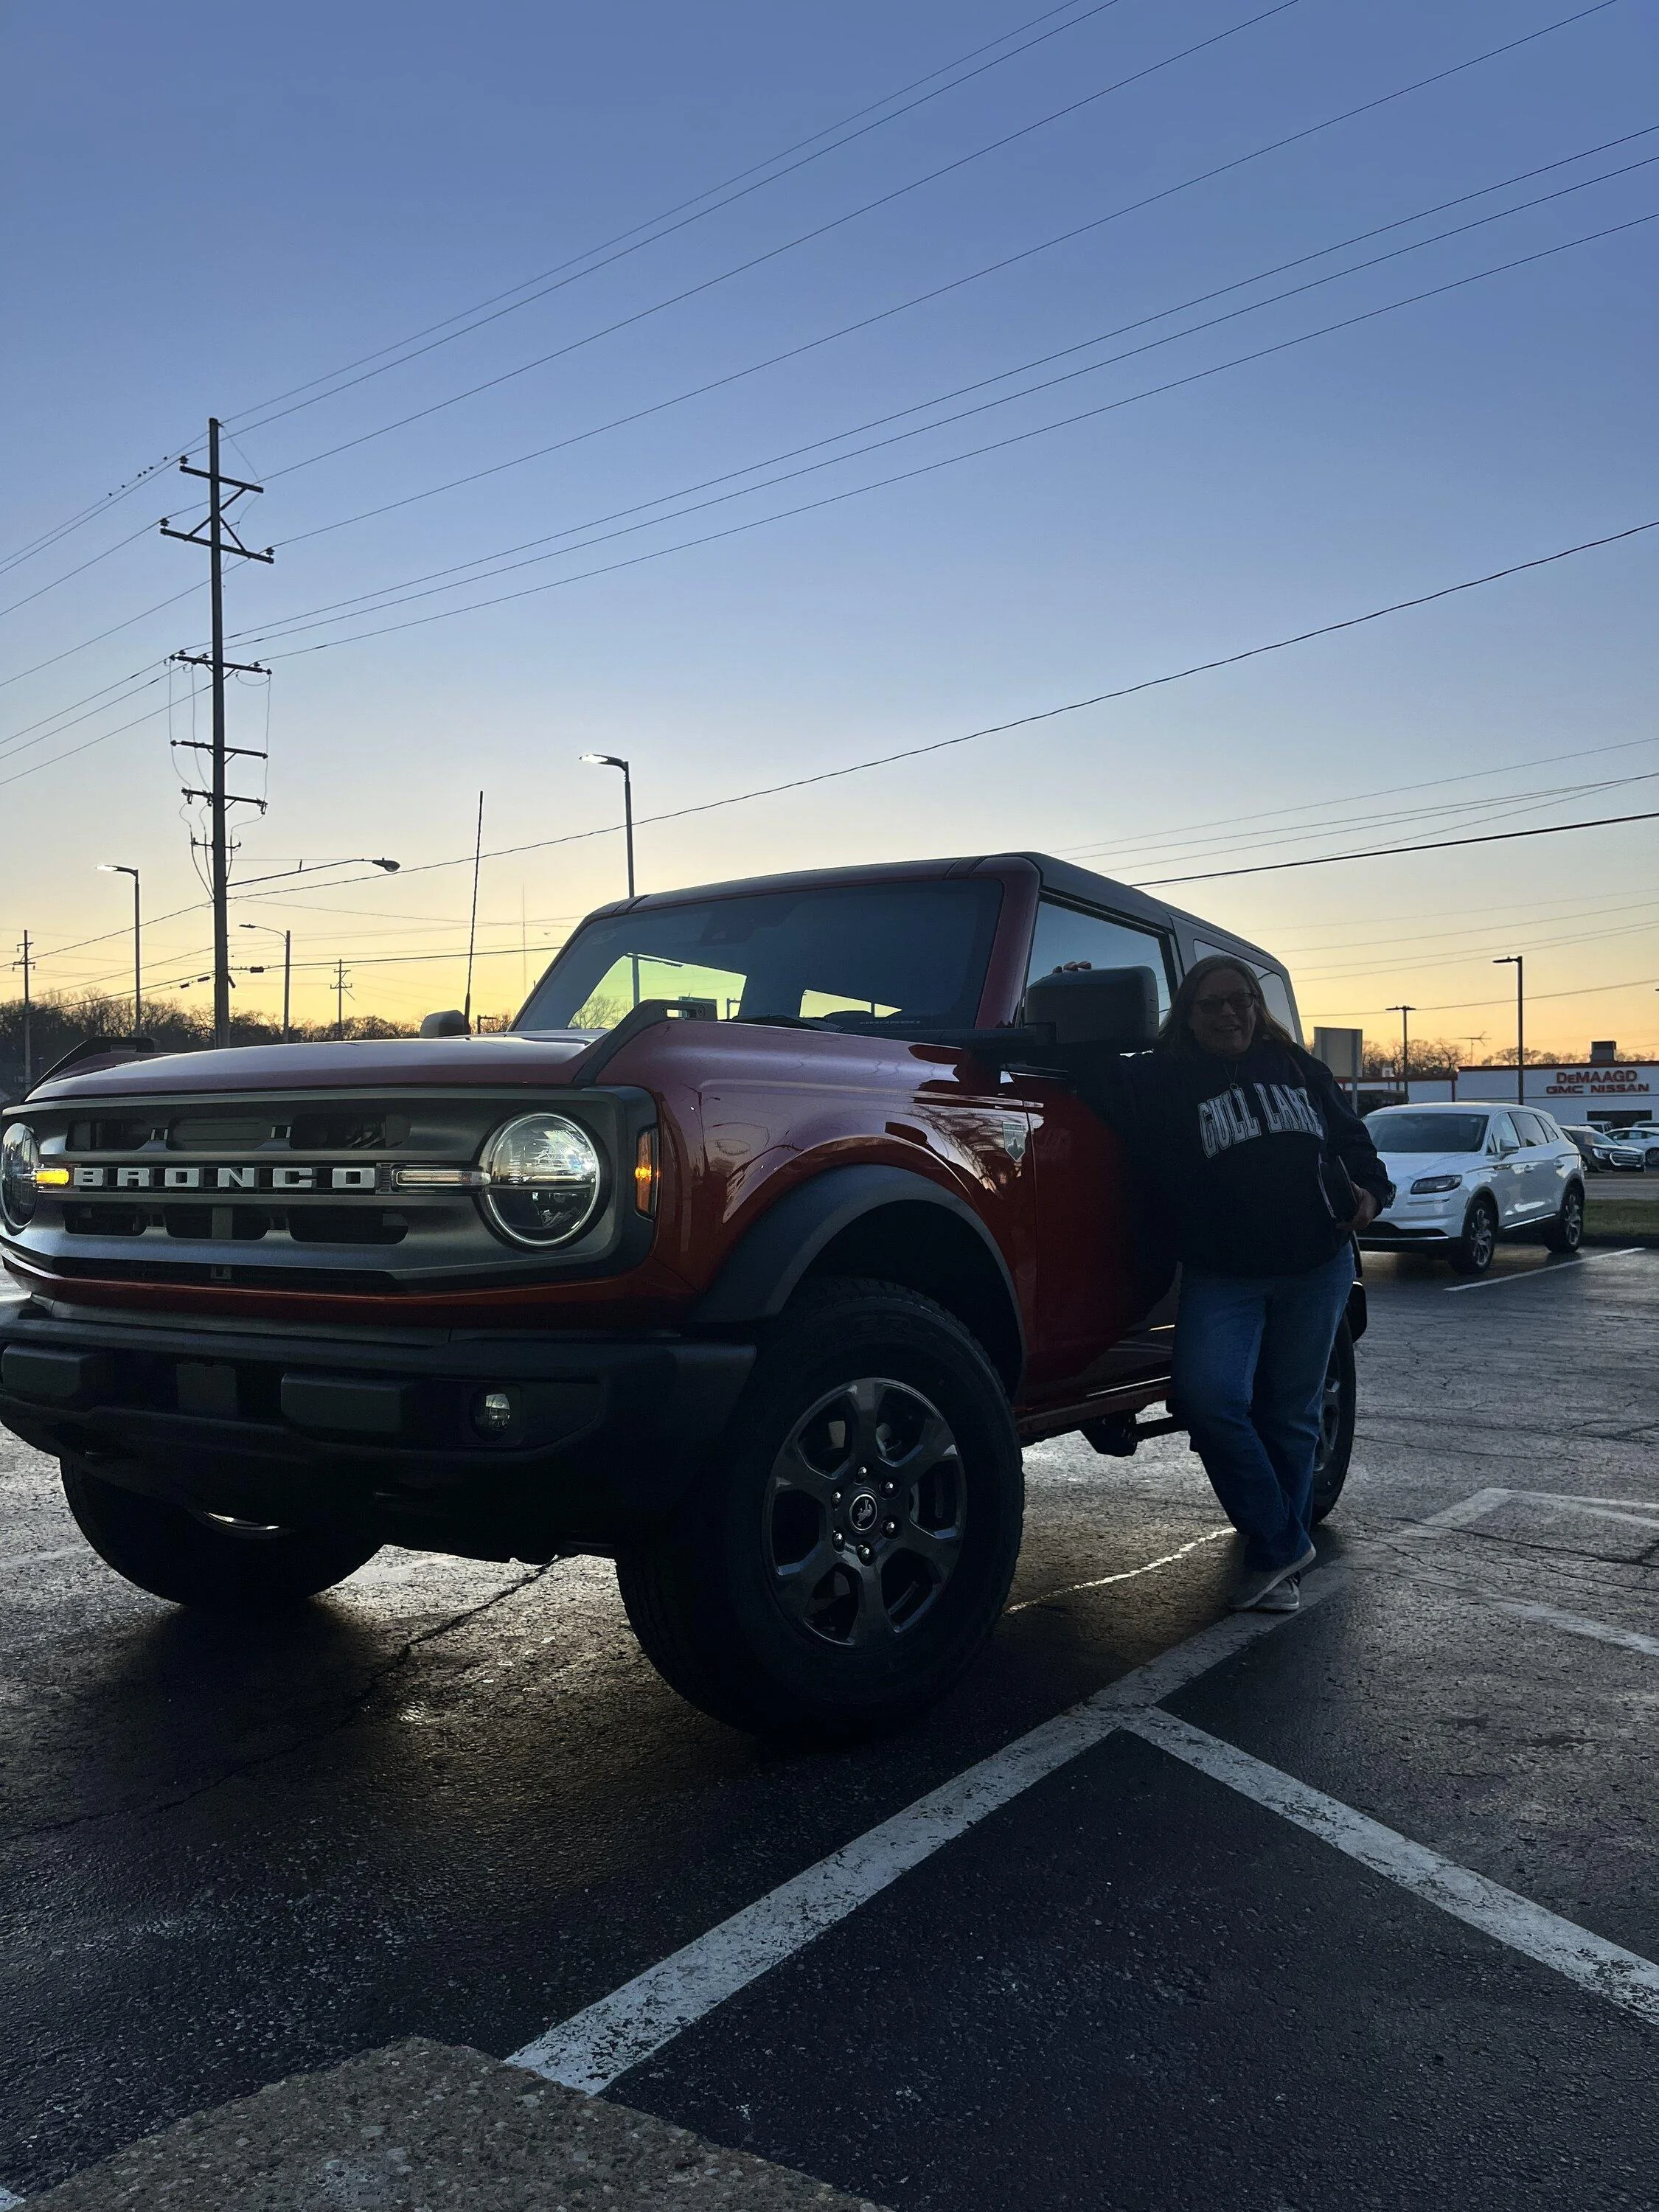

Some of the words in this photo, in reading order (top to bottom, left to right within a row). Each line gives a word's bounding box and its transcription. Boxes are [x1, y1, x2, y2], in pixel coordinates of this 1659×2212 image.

[1546, 1085, 1584, 1094] GMC
[1590, 1083, 1649, 1093] NISSAN
[1197, 1087, 1262, 1158] GULL
[74, 1167, 375, 1189] BRONCO
